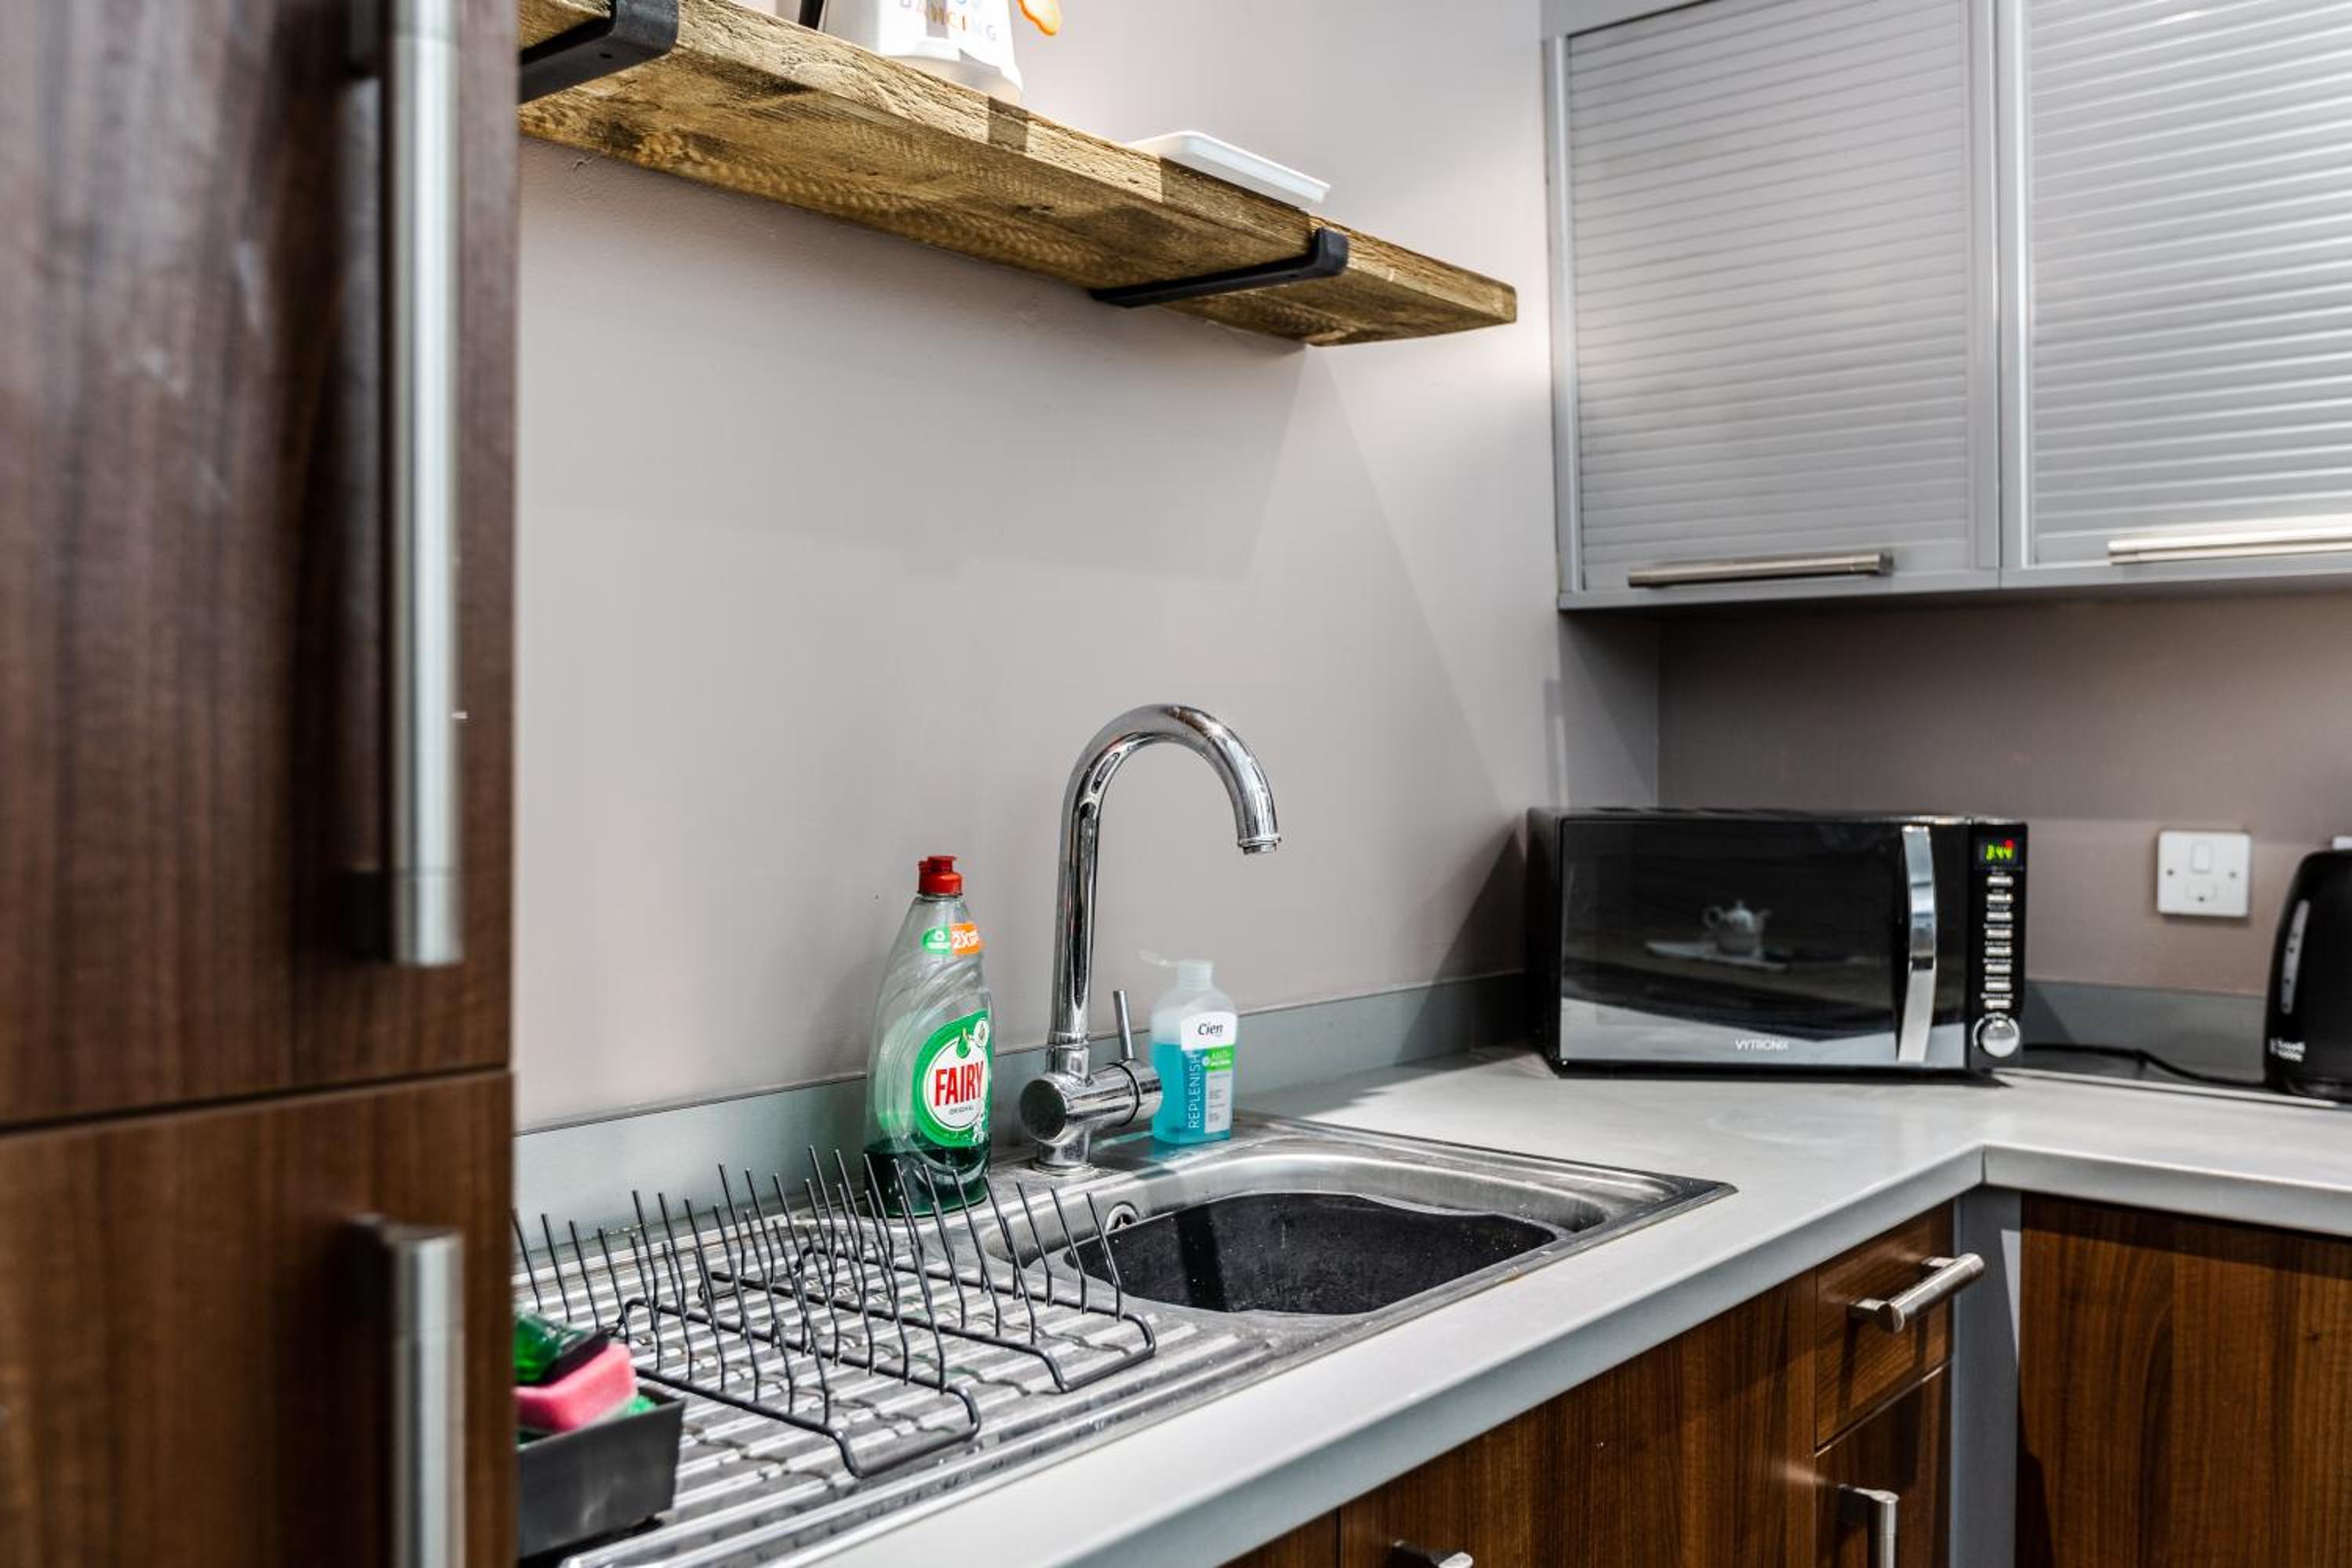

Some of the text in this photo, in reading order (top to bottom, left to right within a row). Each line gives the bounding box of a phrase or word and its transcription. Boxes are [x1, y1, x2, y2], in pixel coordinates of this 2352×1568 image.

[1197, 1022, 1224, 1036] Cien
[935, 1060, 985, 1107] FAIRY
[1188, 1053, 1201, 1128] REPLENISH
